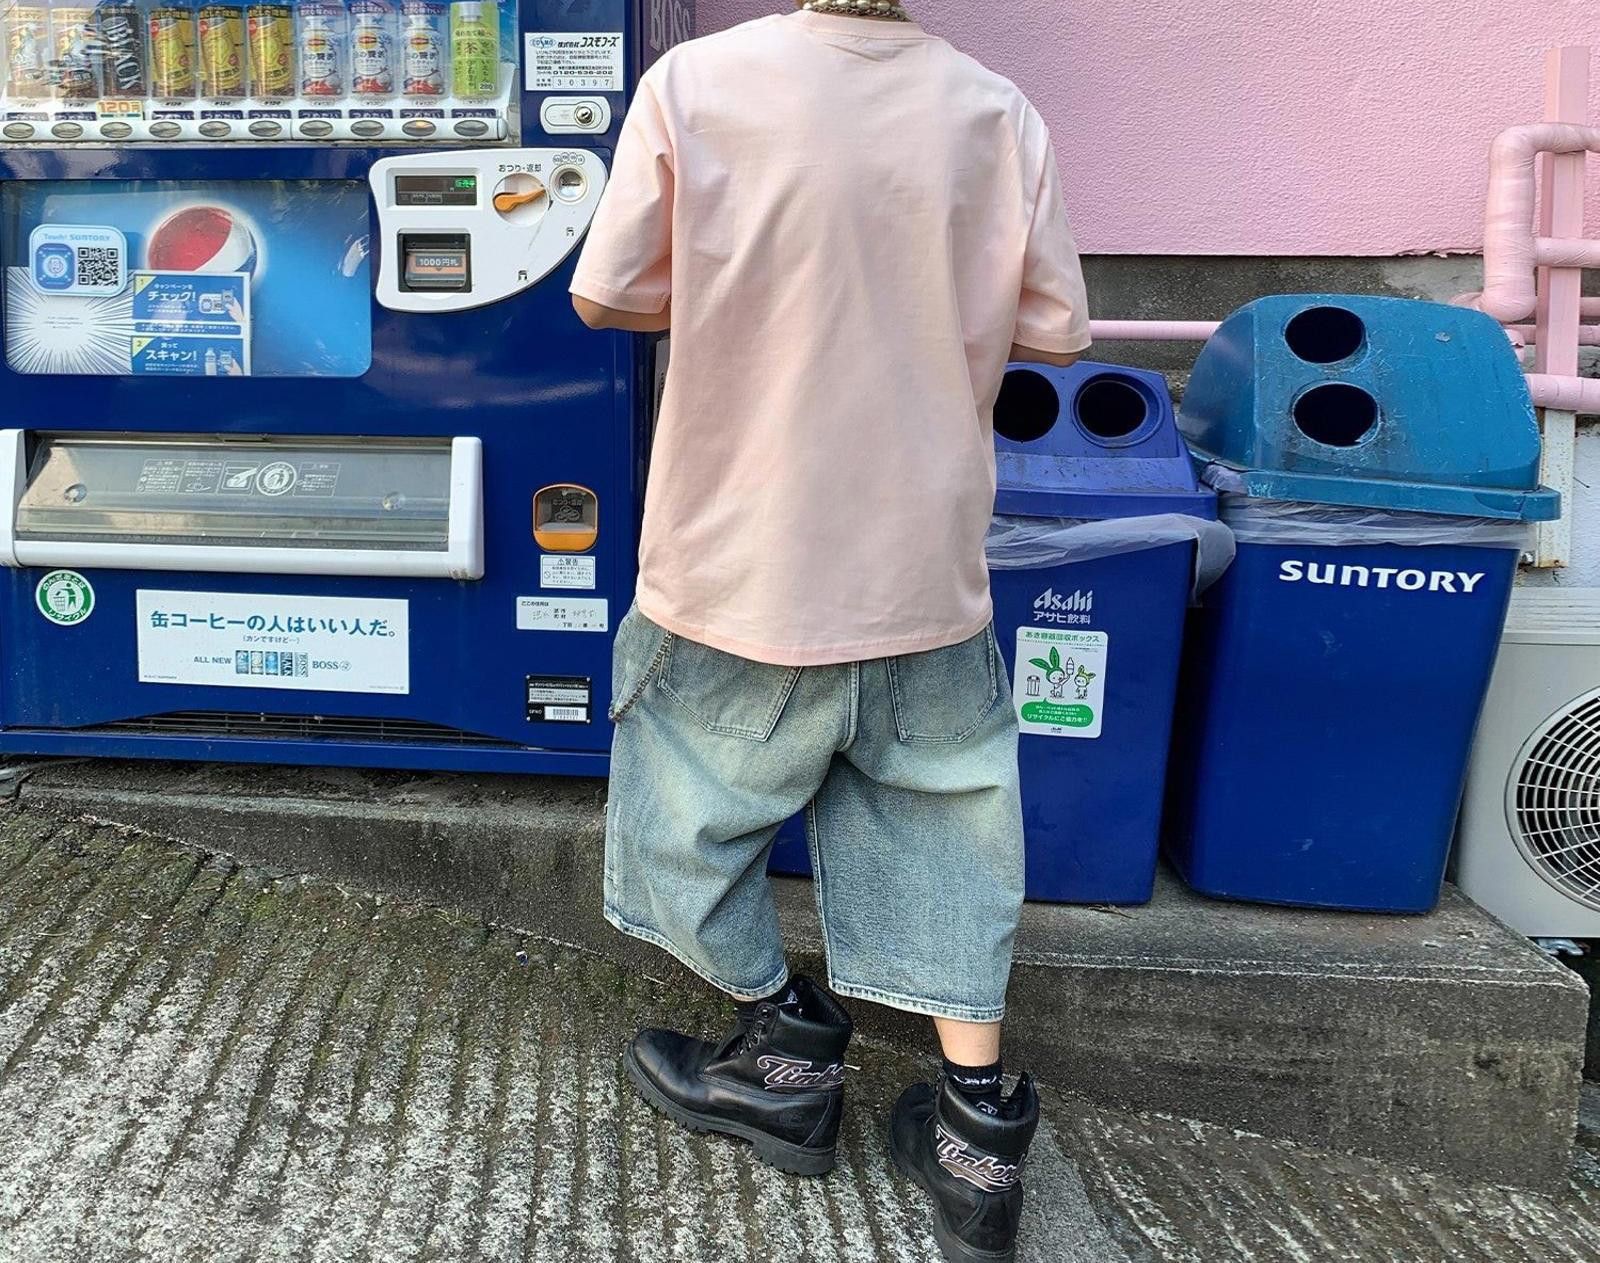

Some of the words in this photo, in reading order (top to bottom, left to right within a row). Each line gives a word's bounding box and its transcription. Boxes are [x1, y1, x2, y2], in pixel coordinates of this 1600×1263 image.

[1278, 560, 1485, 593] SUNTORY
[1033, 587, 1094, 612] Asahi
[150, 610, 396, 638] 缶コーヒーの人はいい人だ。
[1033, 610, 1091, 625] アサヒ飲料
[193, 656, 210, 664] ALL
[212, 656, 232, 665] NEW
[312, 660, 339, 670] BOSS
